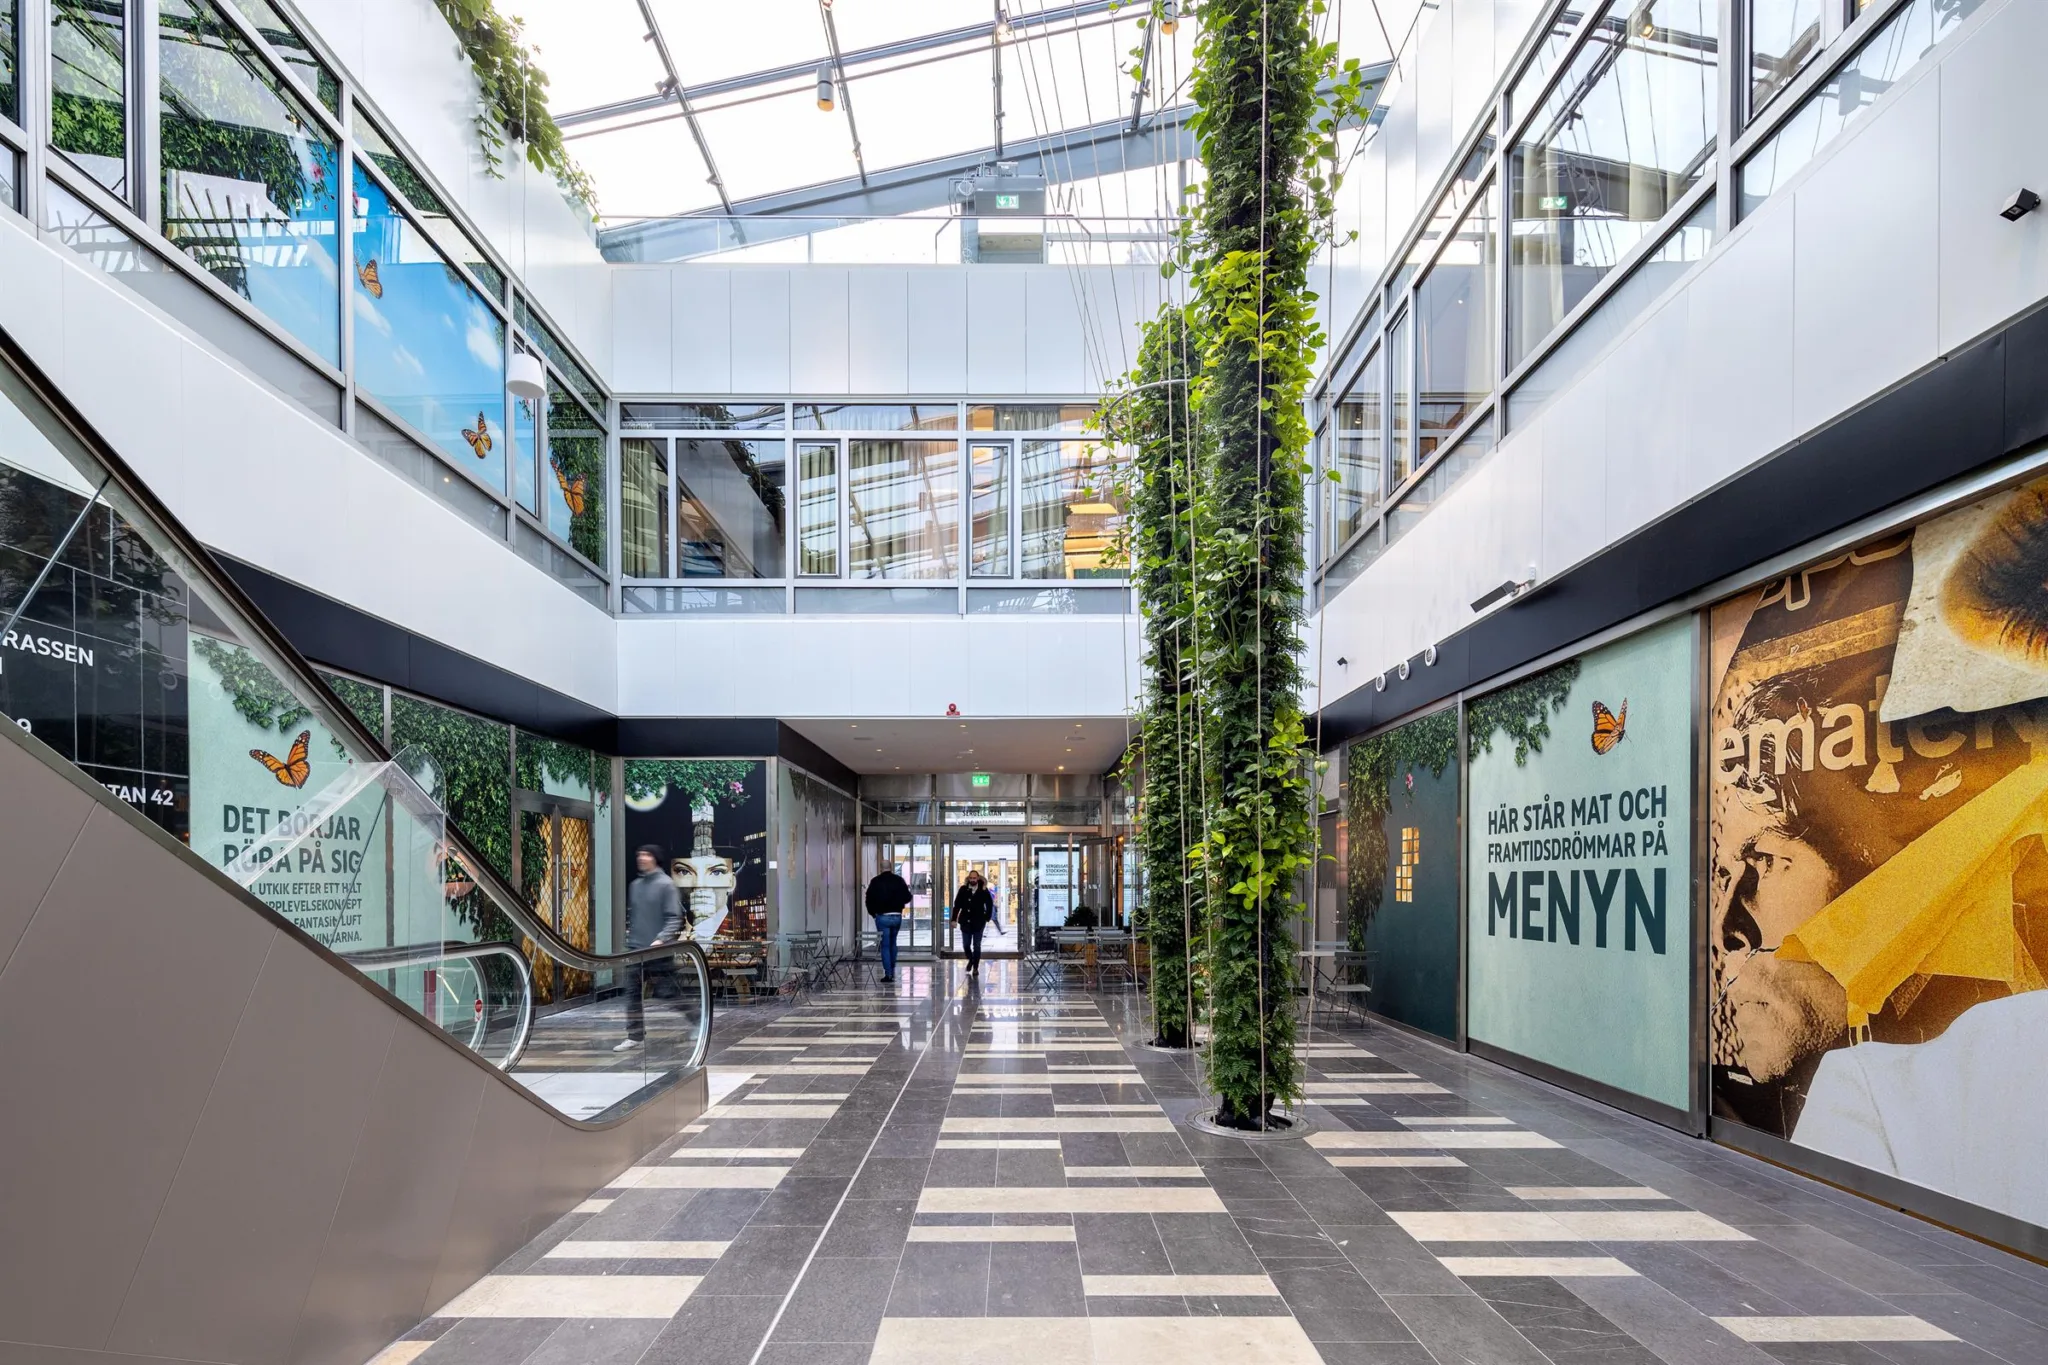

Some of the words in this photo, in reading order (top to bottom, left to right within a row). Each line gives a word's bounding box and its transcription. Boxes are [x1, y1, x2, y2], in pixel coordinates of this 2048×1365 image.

[0, 630, 94, 667] RASSEN
[100, 783, 147, 804] TAN
[150, 788, 174, 806] 42
[1488, 803, 1519, 835] HÄR
[1522, 794, 1565, 832] STÅR
[1571, 793, 1612, 826] MAT
[1618, 785, 1667, 822] OCH
[223, 804, 270, 835] DET
[278, 805, 361, 841] BÖRJAR
[223, 838, 292, 873] RÖRA
[299, 840, 326, 874] PÅ
[331, 849, 362, 874] SIG
[1488, 830, 1636, 863] FRAMTIDSDRÖMMAR
[1642, 820, 1668, 857] PÅ
[258, 883, 291, 895] UTKIK
[292, 883, 322, 895] EFTER
[324, 882, 340, 894] ETT
[341, 914, 362, 926] LUFT
[1488, 867, 1667, 956] MENYN
